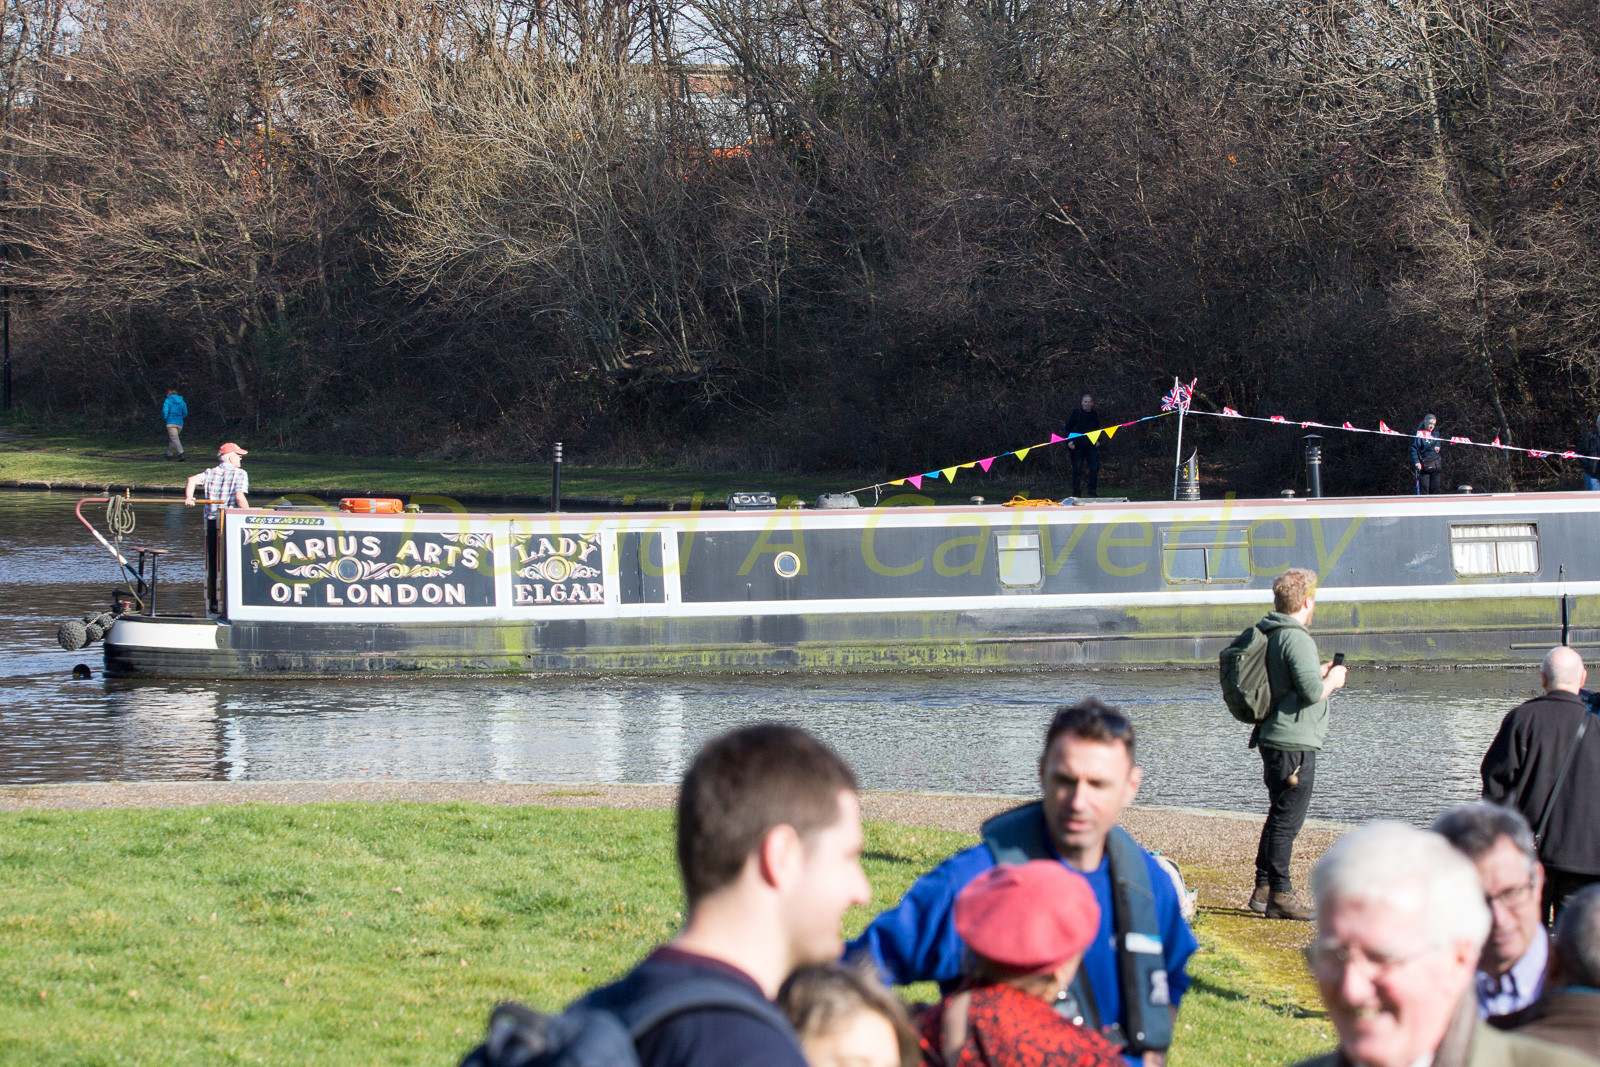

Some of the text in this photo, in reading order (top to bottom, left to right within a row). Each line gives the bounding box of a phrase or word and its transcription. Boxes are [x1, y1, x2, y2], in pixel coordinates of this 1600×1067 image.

[257, 536, 480, 570] DARIUS ARTS
[514, 537, 598, 563] LADY
[270, 583, 467, 606] OF LONDON
[514, 583, 605, 604] ELGAR
